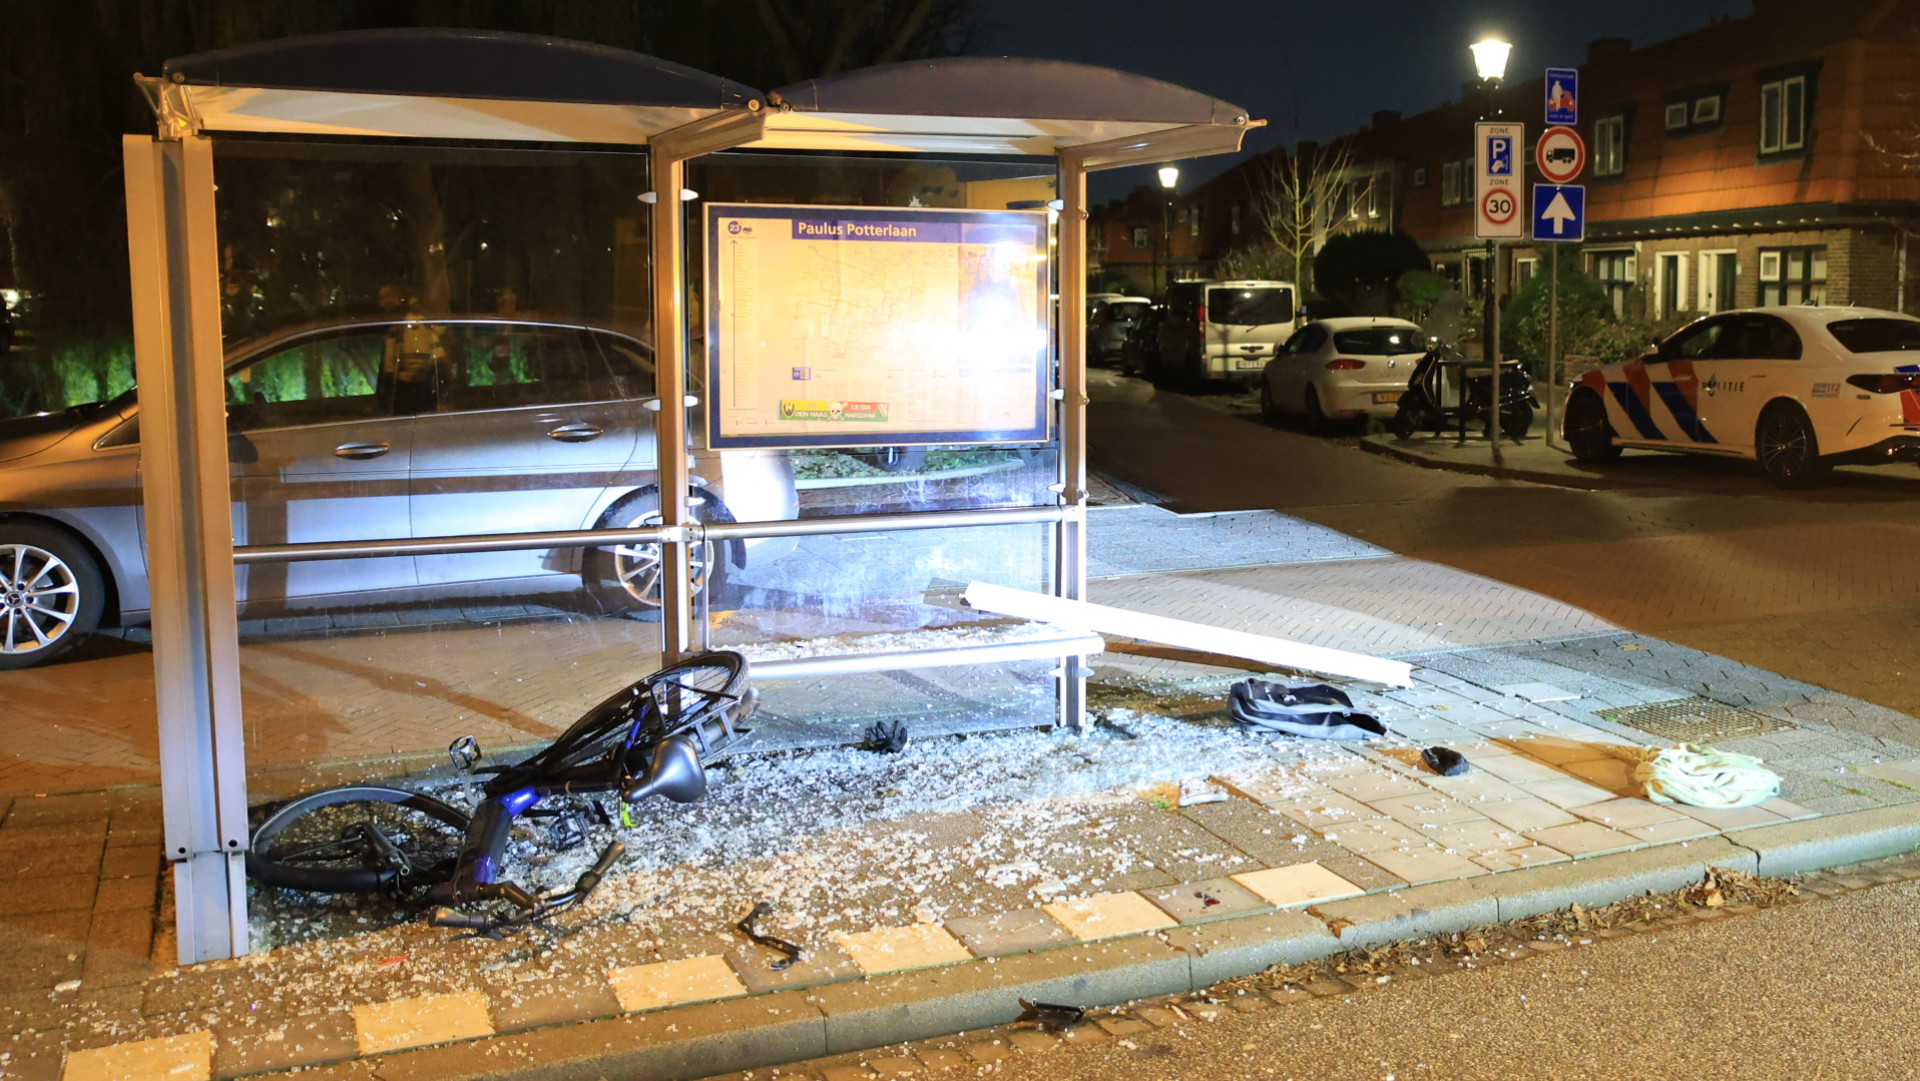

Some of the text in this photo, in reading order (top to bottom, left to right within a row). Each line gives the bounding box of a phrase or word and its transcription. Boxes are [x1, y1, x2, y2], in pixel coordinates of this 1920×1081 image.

[1492, 139, 1506, 160] P
[1488, 199, 1511, 214] 30
[729, 223, 741, 233] 23
[798, 221, 917, 238] Paulus Potterlaan
[1702, 381, 1745, 393] PLITIE
